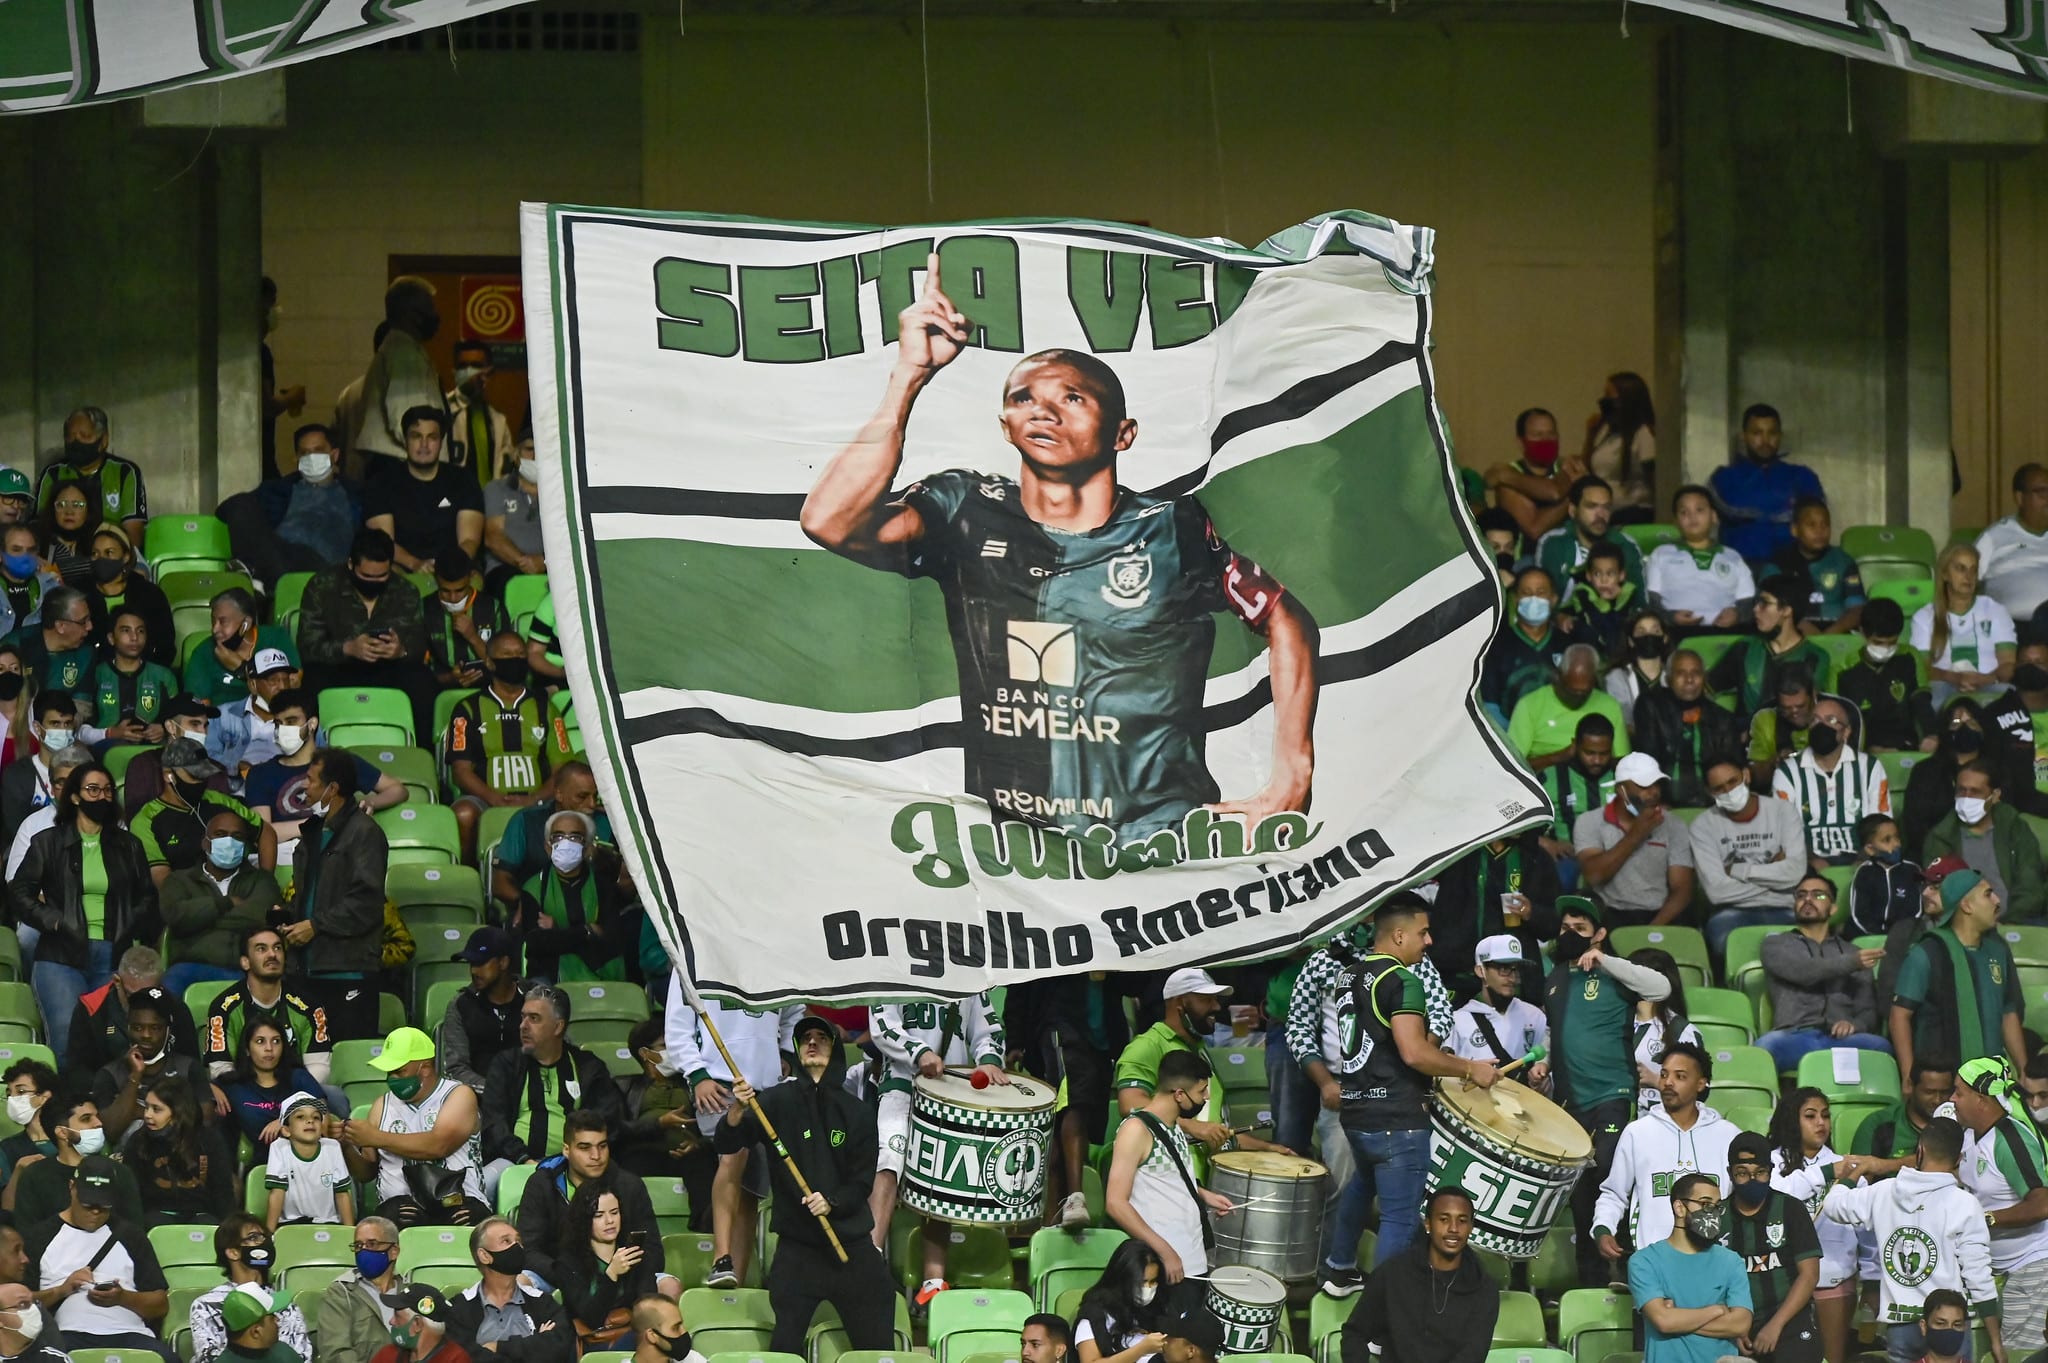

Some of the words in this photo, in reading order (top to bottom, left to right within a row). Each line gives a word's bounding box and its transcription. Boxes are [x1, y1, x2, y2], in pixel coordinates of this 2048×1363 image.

[653, 234, 1025, 364] SEITA
[996, 687, 1086, 710] BANCO
[980, 703, 1122, 745] SEMEAR
[493, 755, 536, 789] FIAT
[1811, 826, 1858, 858] FIAT
[822, 909, 1094, 979] Orgulho
[1747, 1251, 1783, 1274] IXA
